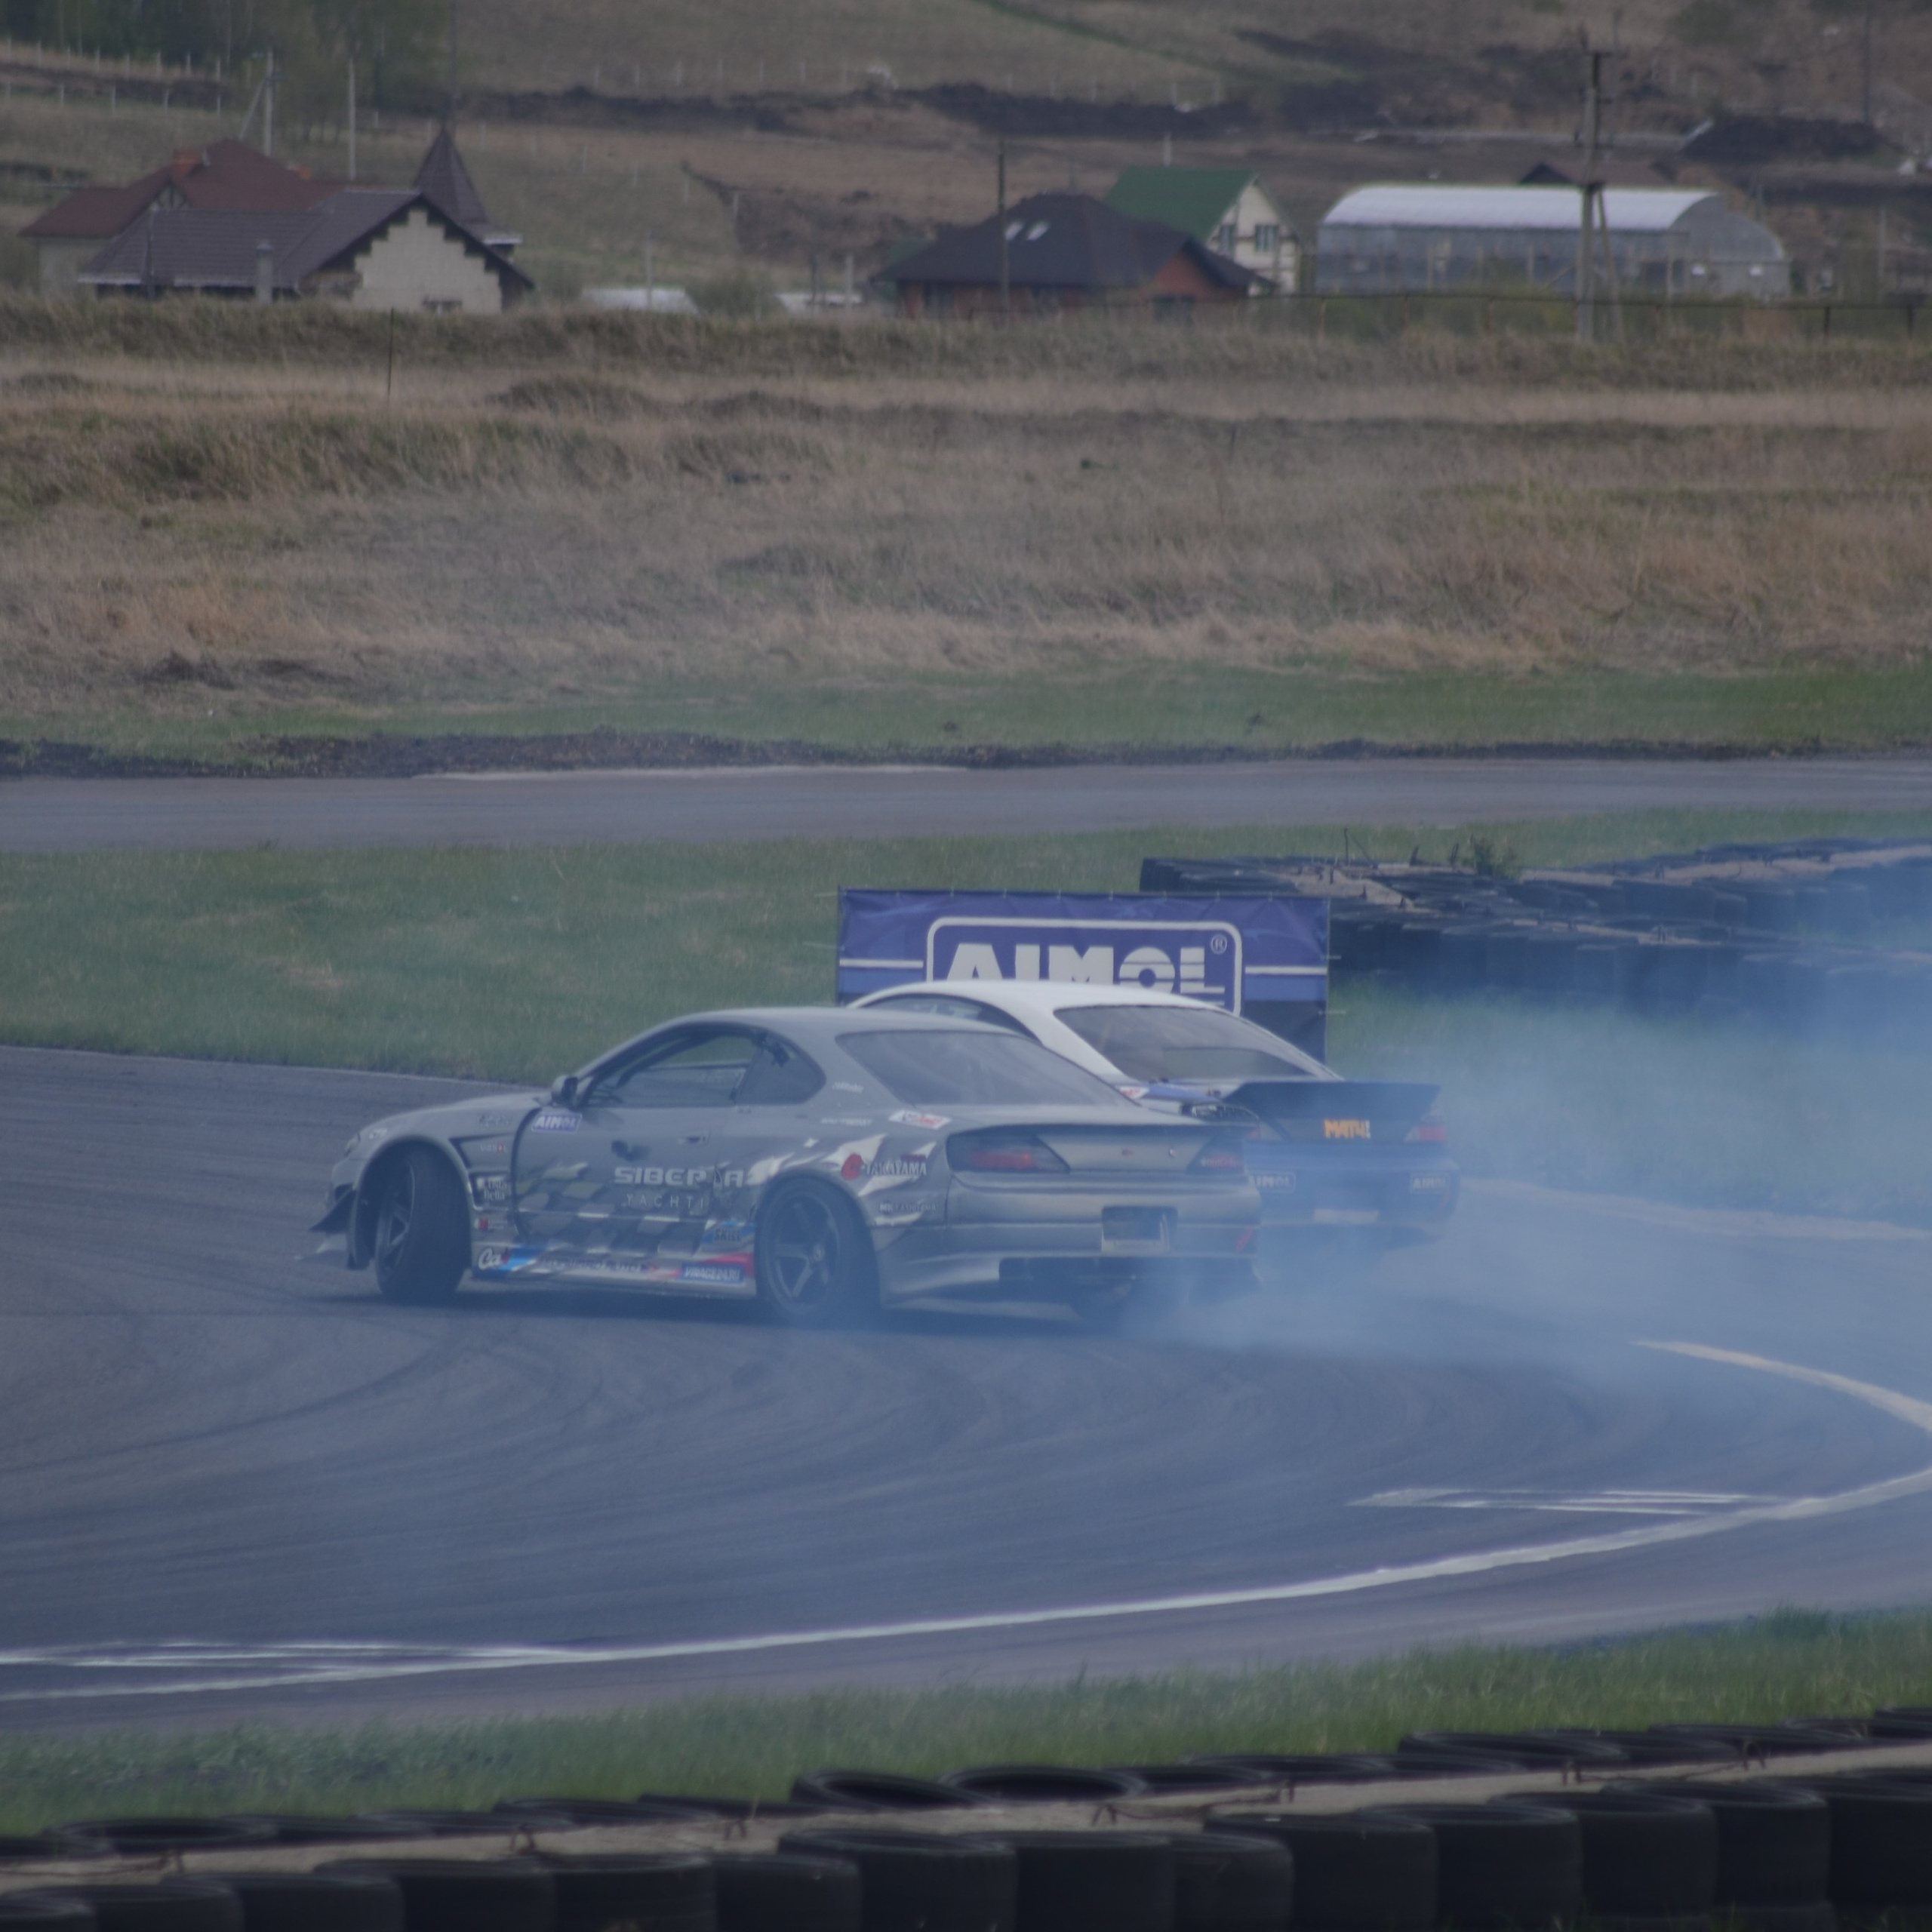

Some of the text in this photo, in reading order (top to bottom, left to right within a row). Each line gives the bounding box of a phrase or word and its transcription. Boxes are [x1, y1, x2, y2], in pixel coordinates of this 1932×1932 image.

[946, 943, 1226, 995] AIMOL
[534, 1115, 576, 1130] AIMOL
[1255, 1175, 1291, 1189] IMOL
